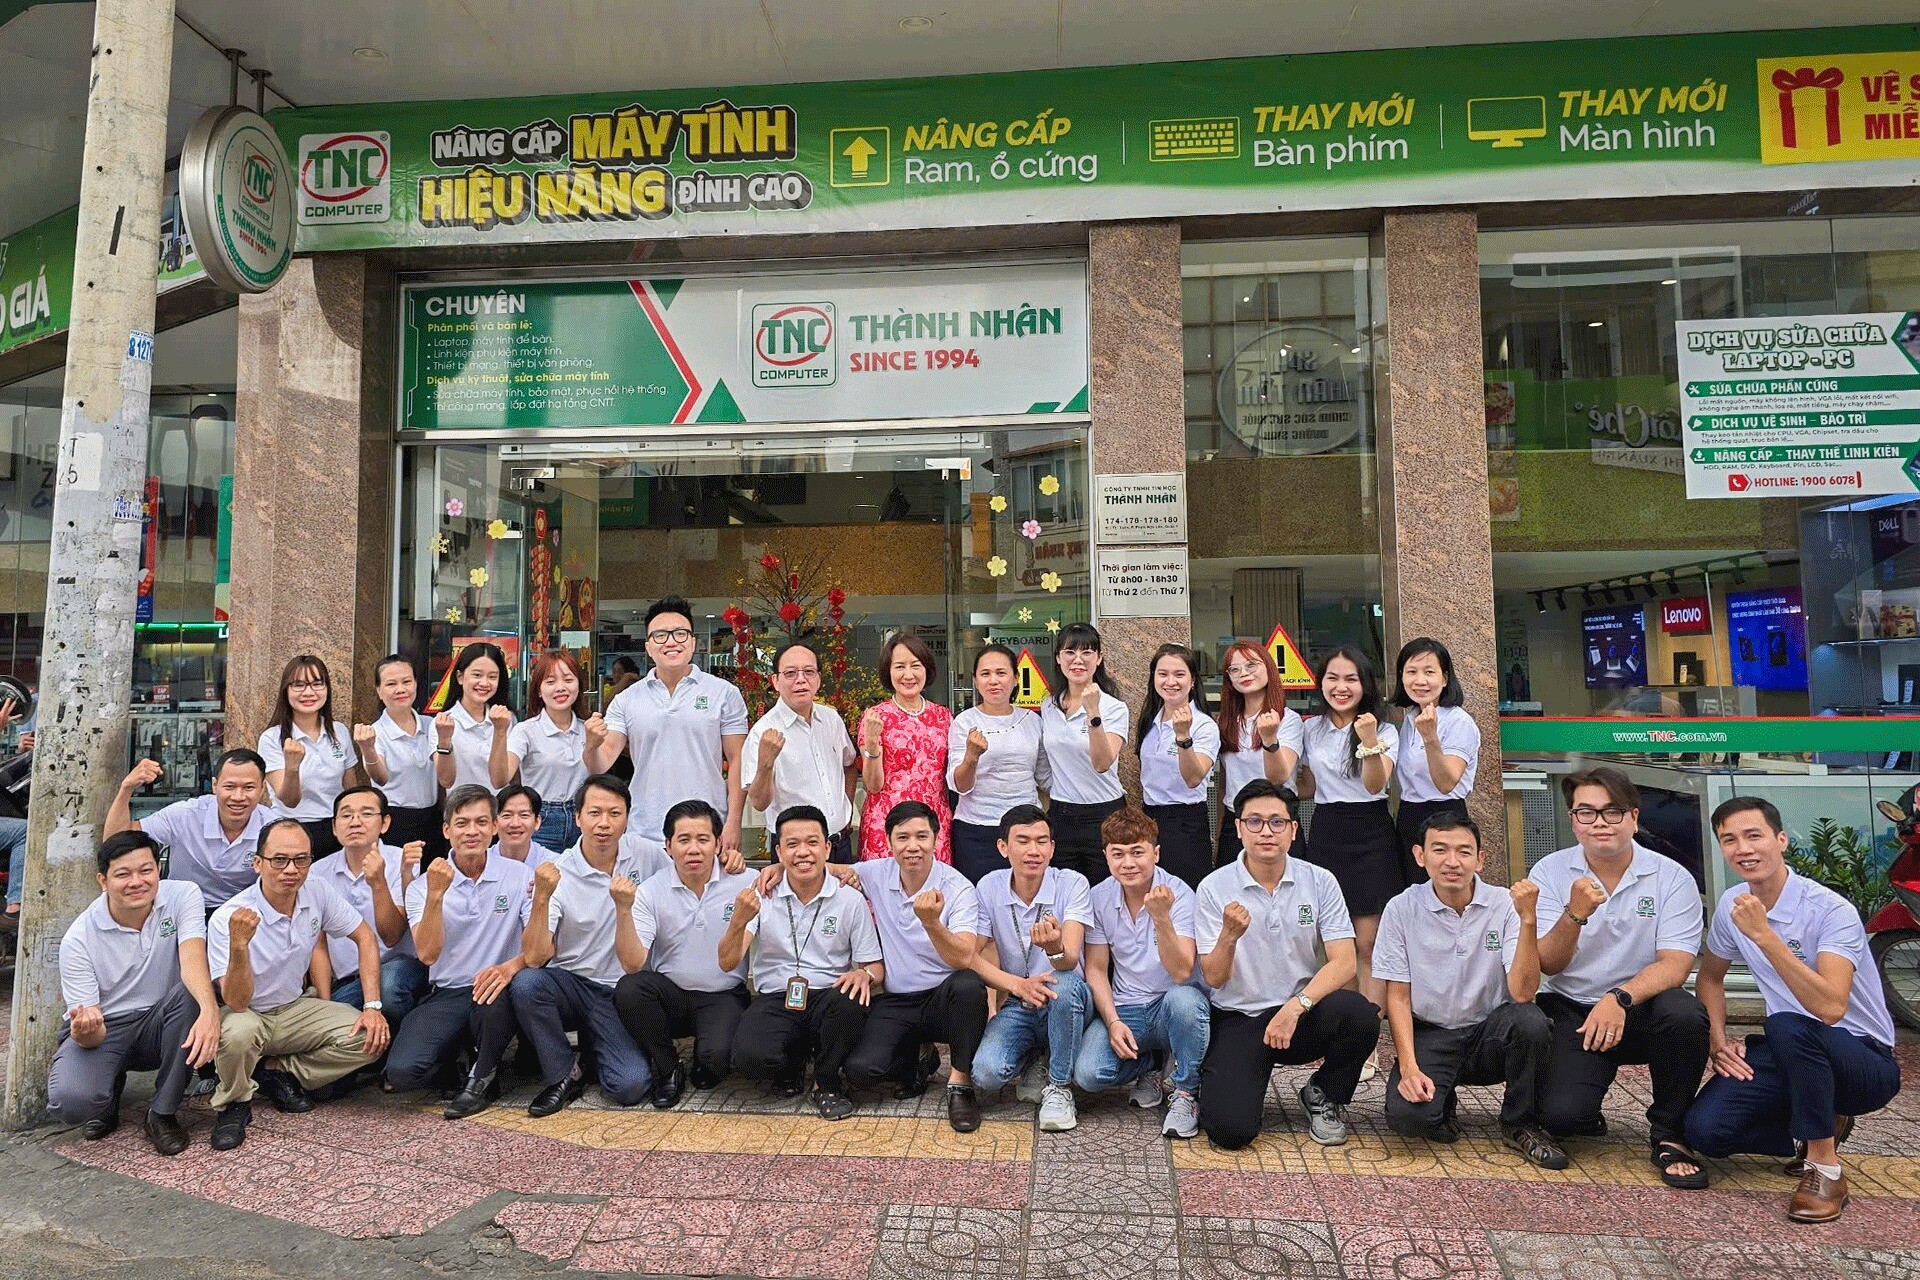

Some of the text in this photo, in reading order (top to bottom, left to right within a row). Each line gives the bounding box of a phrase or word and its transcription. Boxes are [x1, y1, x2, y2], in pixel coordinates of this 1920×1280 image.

[1861, 70, 1900, 105] VỆ
[1558, 78, 1728, 118] THAY MỚI
[1253, 92, 1415, 132] THAY MỚI
[435, 104, 788, 160] NÂNG CẤP MÁY TÍNH
[903, 108, 1072, 151] NÂNG CẤP
[1559, 119, 1715, 152] Màn hình
[1254, 134, 1408, 170] Bàn phím
[307, 148, 382, 189] TNC
[905, 150, 1098, 184] Ram, ổ cứng
[246, 155, 272, 202] TNC
[422, 166, 803, 224] HIỆU NĂNG ĐỈNH CAO
[241, 195, 270, 223] COMPUTER
[305, 204, 383, 218] COMPUTER
[10, 265, 50, 330] GIÁ
[426, 289, 525, 316] CHUYÊN
[428, 320, 532, 333] Phân phối và bán lẻ:
[849, 302, 1063, 343] THÀNH NHÂN
[434, 333, 554, 348] Laptop, máy tính để bàn.
[761, 317, 827, 355] TNC
[1688, 322, 1886, 354] DỊCH VỤ SỬA CHỮA
[434, 346, 565, 359] Linh kiện phụ kiện máy tính.
[850, 348, 980, 373] SINCE 1994
[1722, 349, 1854, 372] LAPTOP PC
[433, 361, 455, 370] Thiết
[503, 359, 525, 369] thiết
[527, 360, 536, 369] bị
[540, 358, 557, 368] văn
[560, 358, 595, 368] phòng.
[427, 371, 610, 386] Dịch vụ kỹ thuật, sửa chữa máy tính
[760, 368, 829, 380] COMPUTER
[481, 389, 502, 399] máy
[528, 387, 548, 396] bảo
[576, 387, 601, 397] phục
[622, 385, 634, 396] hệ
[637, 383, 668, 396] thống.
[1806, 380, 1838, 391] CỨNG
[447, 401, 474, 411] công
[510, 399, 526, 409] lắp
[529, 400, 546, 409] đặt
[548, 399, 561, 409] hạ
[565, 398, 587, 409] tầng
[1711, 418, 1738, 429] DỊCH
[1742, 417, 1758, 428] VỤ
[1779, 415, 1806, 426] SINH
[1820, 413, 1845, 425] BẢO
[1714, 450, 1746, 461] NÂNG
[1750, 447, 1773, 460] CẤP
[1786, 449, 1816, 460] THAY
[1818, 445, 1841, 458] THẾ
[1843, 447, 1870, 458] LINH
[1755, 475, 1855, 486] HOTLINE: 1900 6078
[1105, 492, 1176, 504] THÀNH NHÂN
[1878, 517, 1899, 531] DELL
[1122, 565, 1140, 573] gian
[1162, 563, 1183, 572] việc:
[1113, 588, 1130, 596] Thứ
[1161, 587, 1177, 595] Thứ
[1664, 607, 1702, 624] Lenovo
[992, 636, 1050, 645] KEYBOARD
[1613, 731, 1727, 742] www.TNC.com.vn
